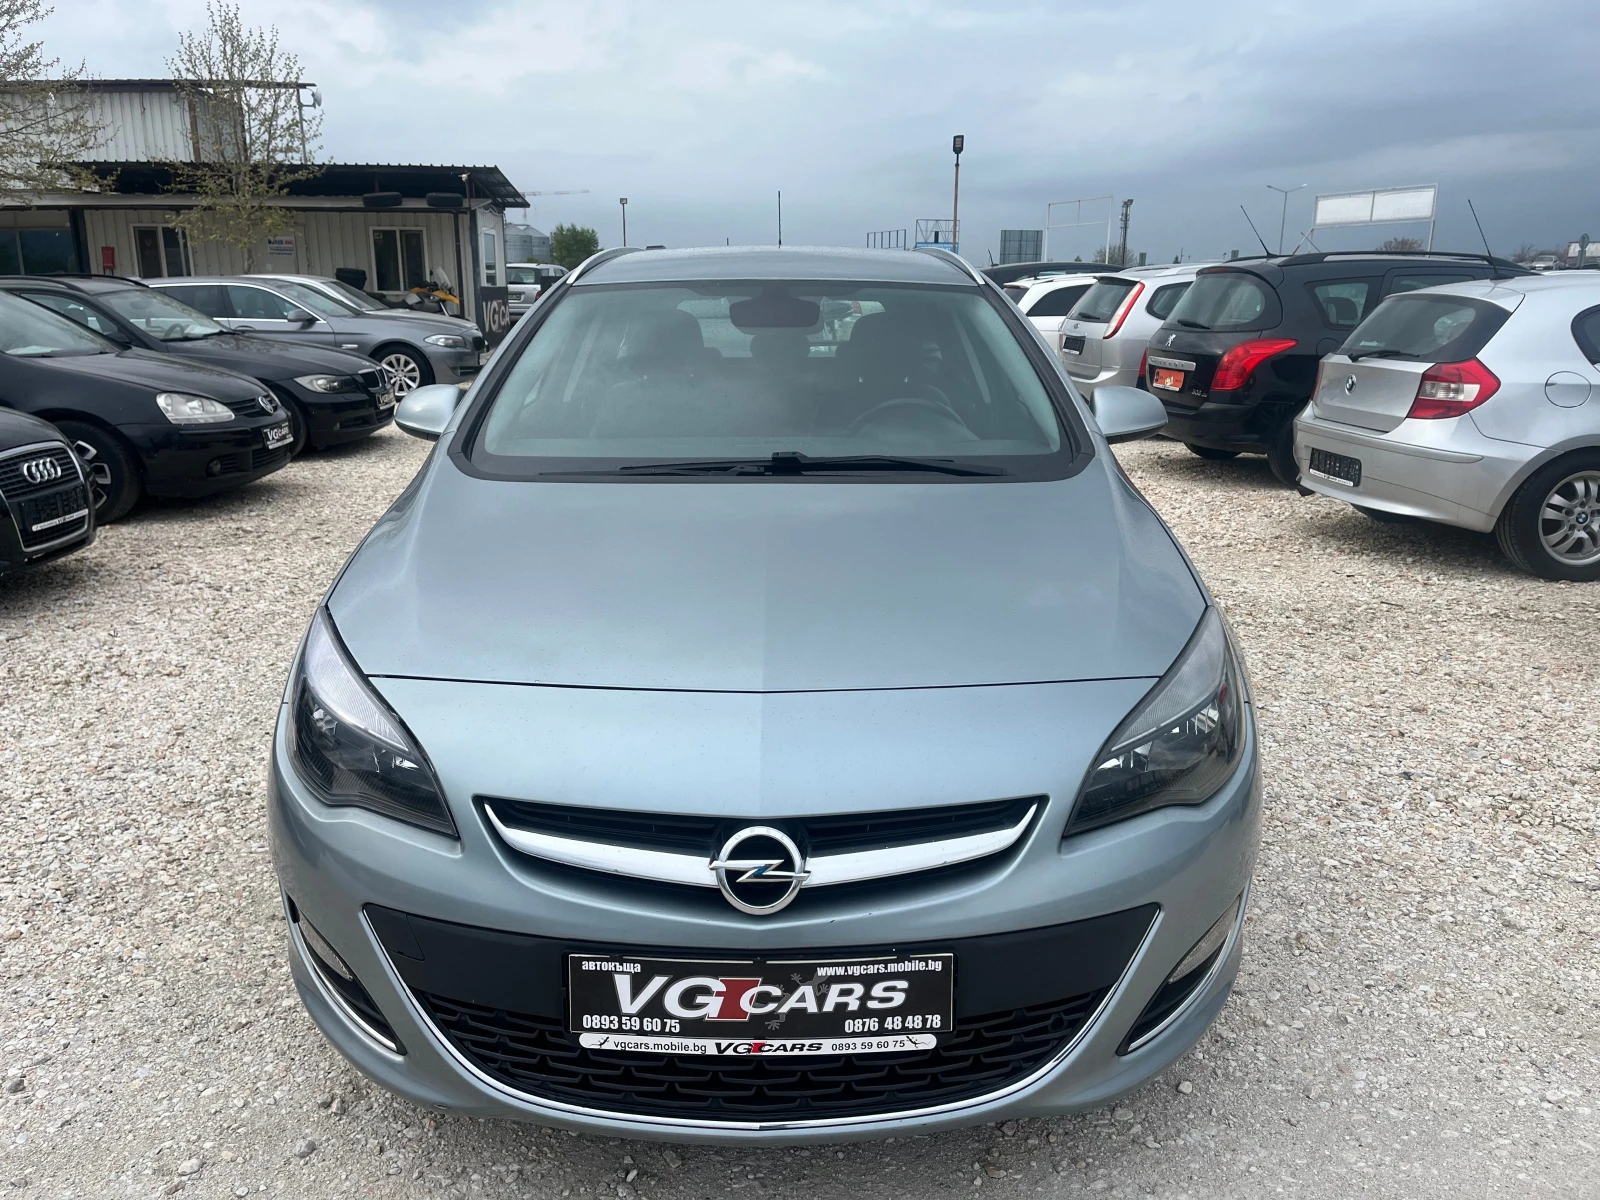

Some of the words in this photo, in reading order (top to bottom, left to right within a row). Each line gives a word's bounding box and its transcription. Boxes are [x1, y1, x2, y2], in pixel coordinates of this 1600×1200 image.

[734, 828, 786, 841] OPEL
[581, 960, 642, 974] автокъща
[816, 959, 943, 977] www.vgcars.mobile.bg
[582, 1014, 619, 1030] 0893
[621, 1016, 640, 1031] 59
[643, 1018, 662, 1033] 60
[664, 1019, 681, 1033] 75
[844, 1017, 879, 1033] 0876
[884, 1016, 902, 1031] 48
[904, 1015, 923, 1030] 48
[925, 1014, 942, 1029] 78
[613, 1039, 707, 1054] vgcars.mobile.bg
[831, 1042, 857, 1051] 0893
[860, 1041, 874, 1050] 59
[876, 1040, 890, 1049] 60
[892, 1039, 906, 1048] 75
